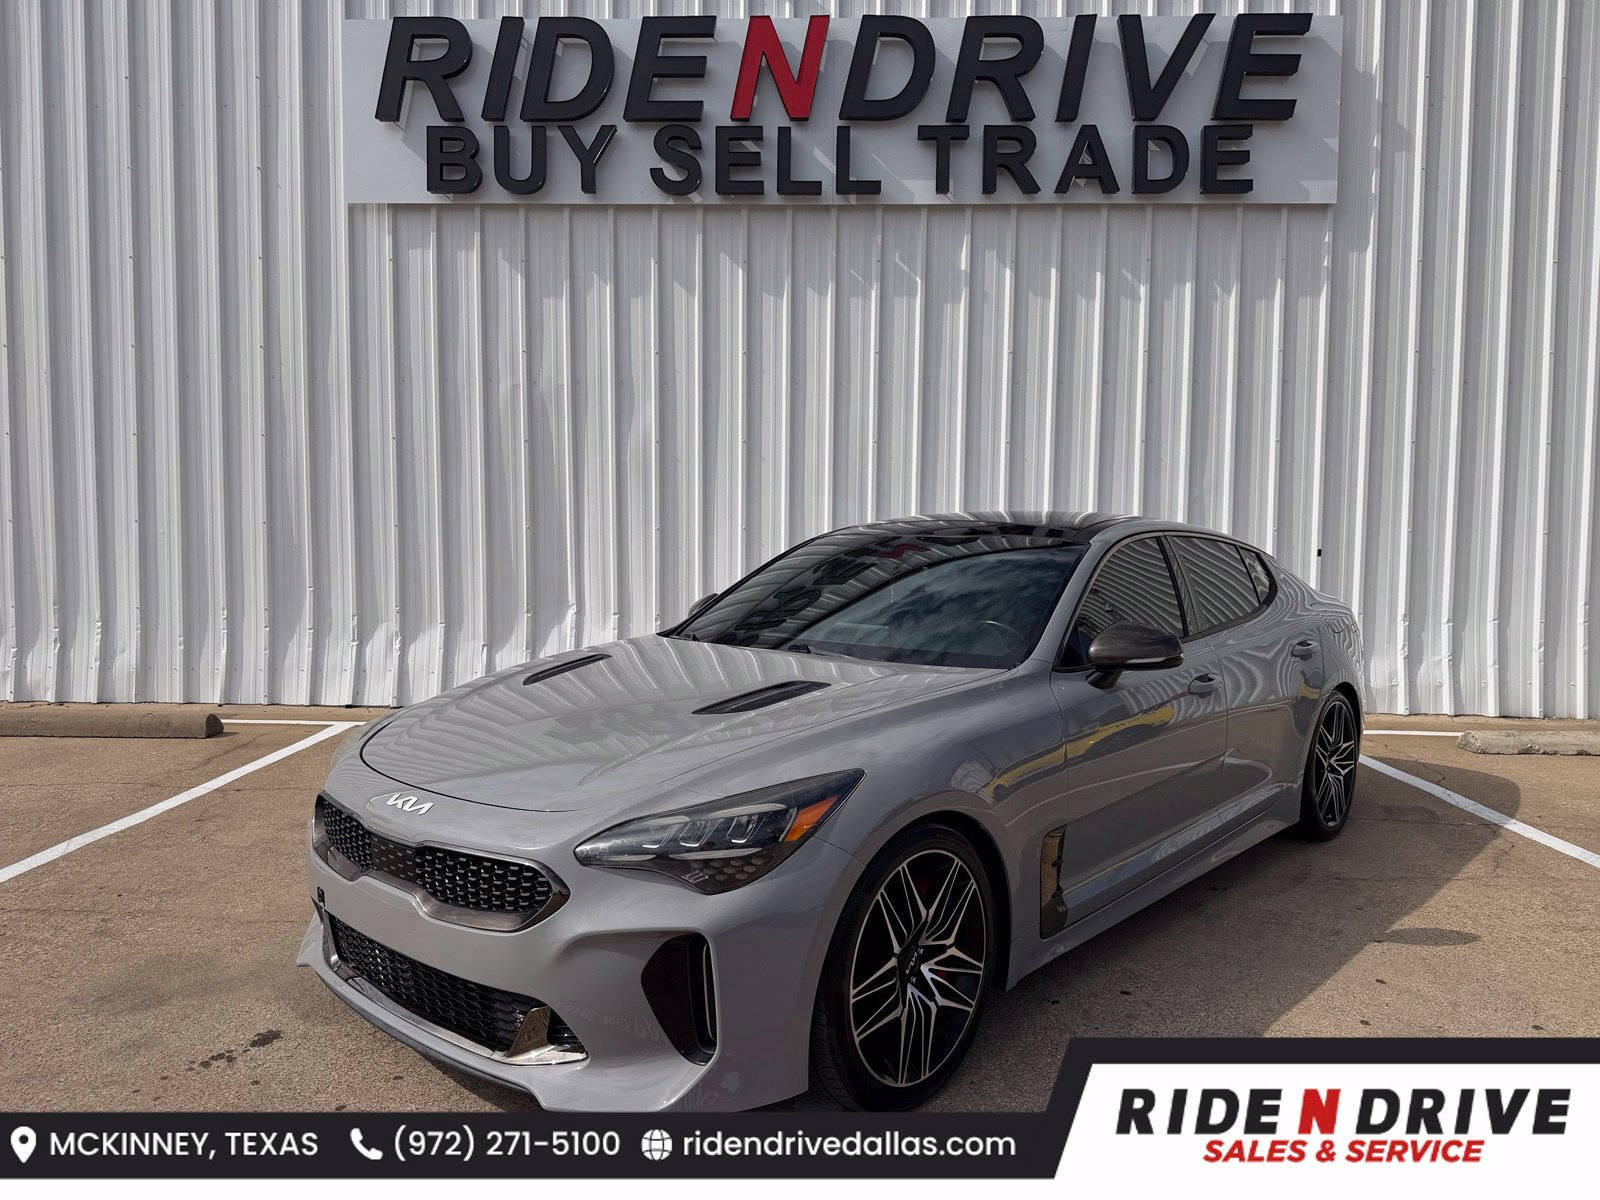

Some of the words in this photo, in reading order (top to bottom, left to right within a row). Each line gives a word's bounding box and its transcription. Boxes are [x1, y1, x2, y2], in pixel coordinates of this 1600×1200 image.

[427, 125, 618, 194] BUY
[650, 125, 882, 195] SELL
[917, 124, 1254, 194] TRADE
[386, 792, 434, 816] KIA
